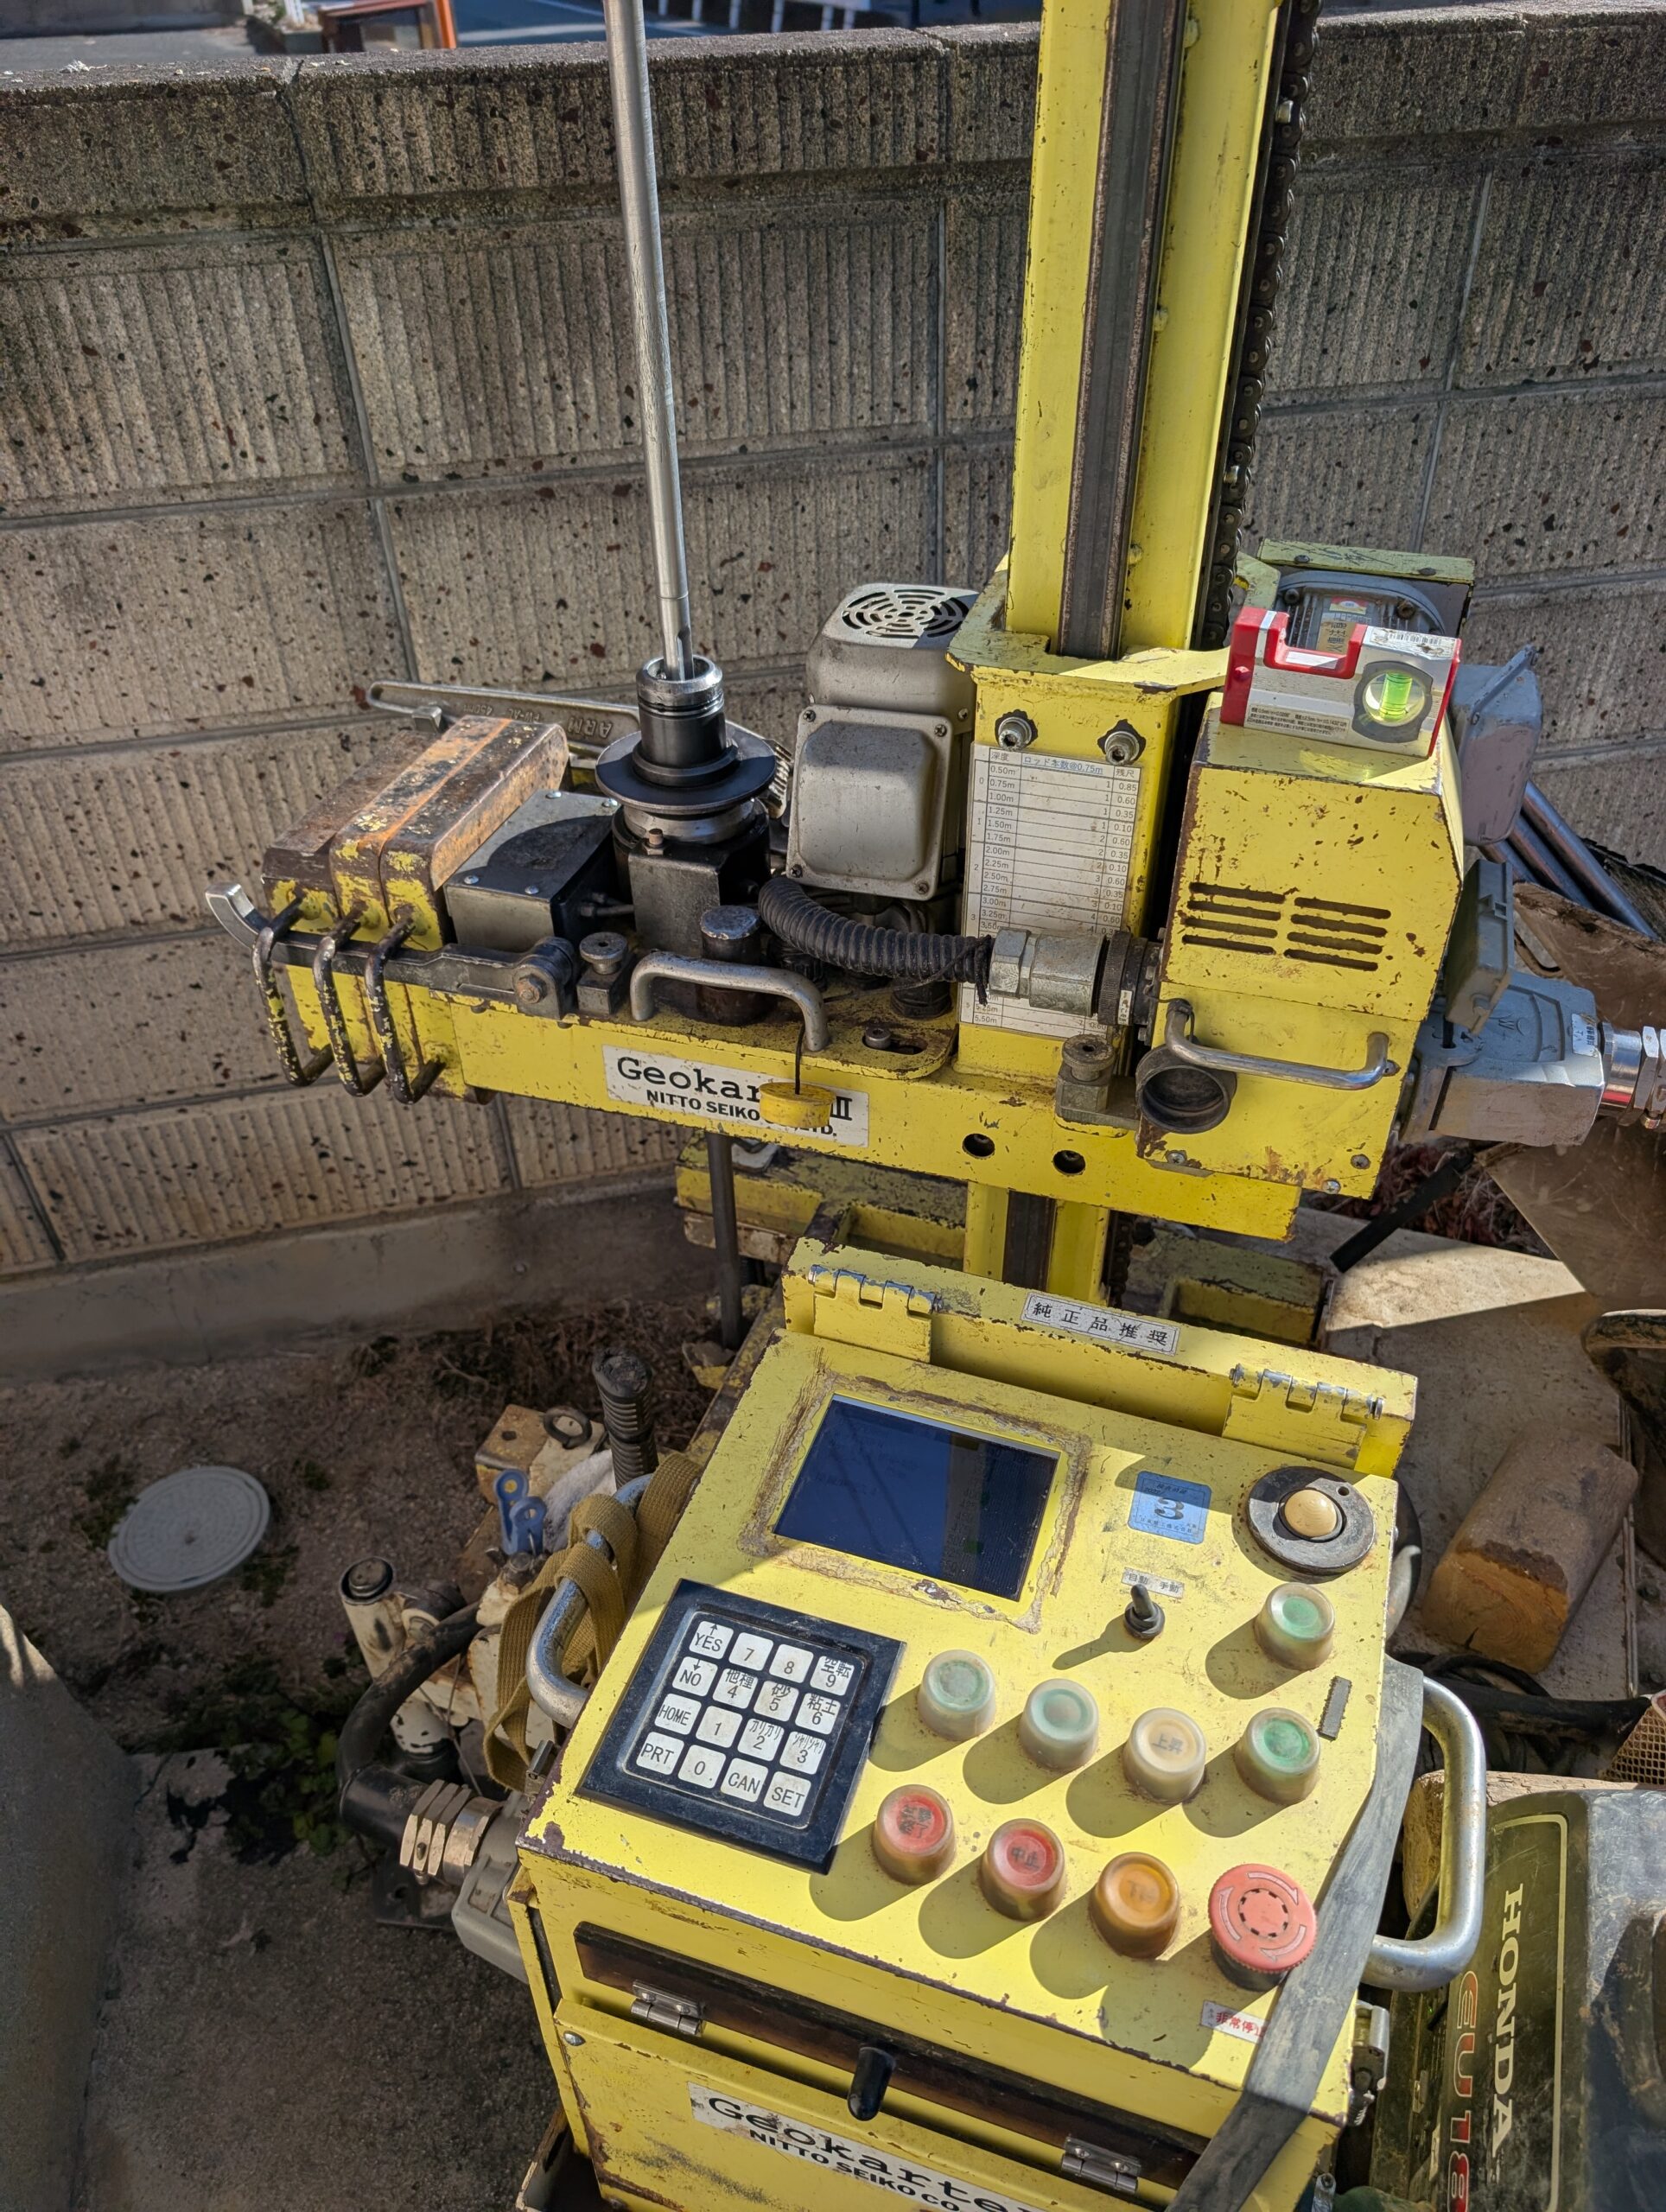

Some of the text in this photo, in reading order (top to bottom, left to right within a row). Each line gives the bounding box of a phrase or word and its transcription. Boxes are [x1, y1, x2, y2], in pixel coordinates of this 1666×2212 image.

[567, 716, 613, 739] ARM
[990, 752, 1009, 761] 深度
[1116, 768, 1135, 778] 残尺
[990, 766, 1016, 776] 0.50m
[1119, 783, 1137, 792] 0.85
[989, 779, 1015, 789] 0.75m
[1117, 796, 1135, 805] 0.60
[989, 792, 1014, 803] 1.00m
[1116, 810, 1134, 819] 0.35
[989, 806, 1013, 817] 1.25m
[1114, 823, 1132, 833] 0.10
[988, 820, 1012, 830] 1.50m
[1112, 837, 1130, 847] 0.60
[987, 833, 1011, 843] 1.75m
[1110, 850, 1129, 860] 0.35
[986, 846, 1010, 856] 2.00m
[1109, 864, 1127, 873] 0.10
[985, 859, 1009, 869] 2.25m
[1107, 876, 1125, 886] 0.60
[984, 872, 1008, 882] 2.50m
[1106, 889, 1123, 899] 0.35
[983, 884, 1008, 894] 2.75m
[1104, 902, 1122, 912] 0.10
[982, 897, 1006, 907] 3.00m
[1103, 915, 1121, 924] 0.60
[982, 909, 1005, 920] 3.25m
[975, 1014, 997, 1023] 5.50m
[617, 1056, 761, 1103] Geokar
[646, 1090, 760, 1121] NITTO SEIKO
[1033, 1301, 1168, 1346] 純正品推奨
[1154, 1497, 1185, 1521] 3
[1129, 1573, 1180, 1593] 自動 手動
[694, 1632, 723, 1653] YES
[743, 1648, 755, 1662] 7
[679, 1669, 702, 1687] NO
[784, 1661, 795, 1675] 8
[821, 1656, 852, 1679] 空転
[726, 1669, 755, 1691] 他種
[771, 1683, 791, 1698] 砂
[825, 1674, 836, 1688] 9
[727, 1685, 737, 1699] 4
[658, 1704, 690, 1727] HOME
[768, 1697, 779, 1712] 5
[807, 1694, 836, 1716] 粘土
[714, 1722, 723, 1737] 1
[812, 1711, 823, 1726] 6
[640, 1743, 674, 1765] PRT
[753, 1735, 766, 1750] 2
[1151, 1732, 1185, 1755] 上昇
[797, 1749, 808, 1764] 3
[728, 1771, 760, 1795] CAN
[771, 1786, 804, 1808] SET
[1011, 1846, 1040, 1872] 中止
[1491, 1883, 1524, 2158] HONDA
[1447, 1970, 1478, 2212] EU18
[709, 2096, 1008, 2212] Geokarte
[749, 2129, 830, 2164] NITTO
[836, 2160, 917, 2196] SEIKO
